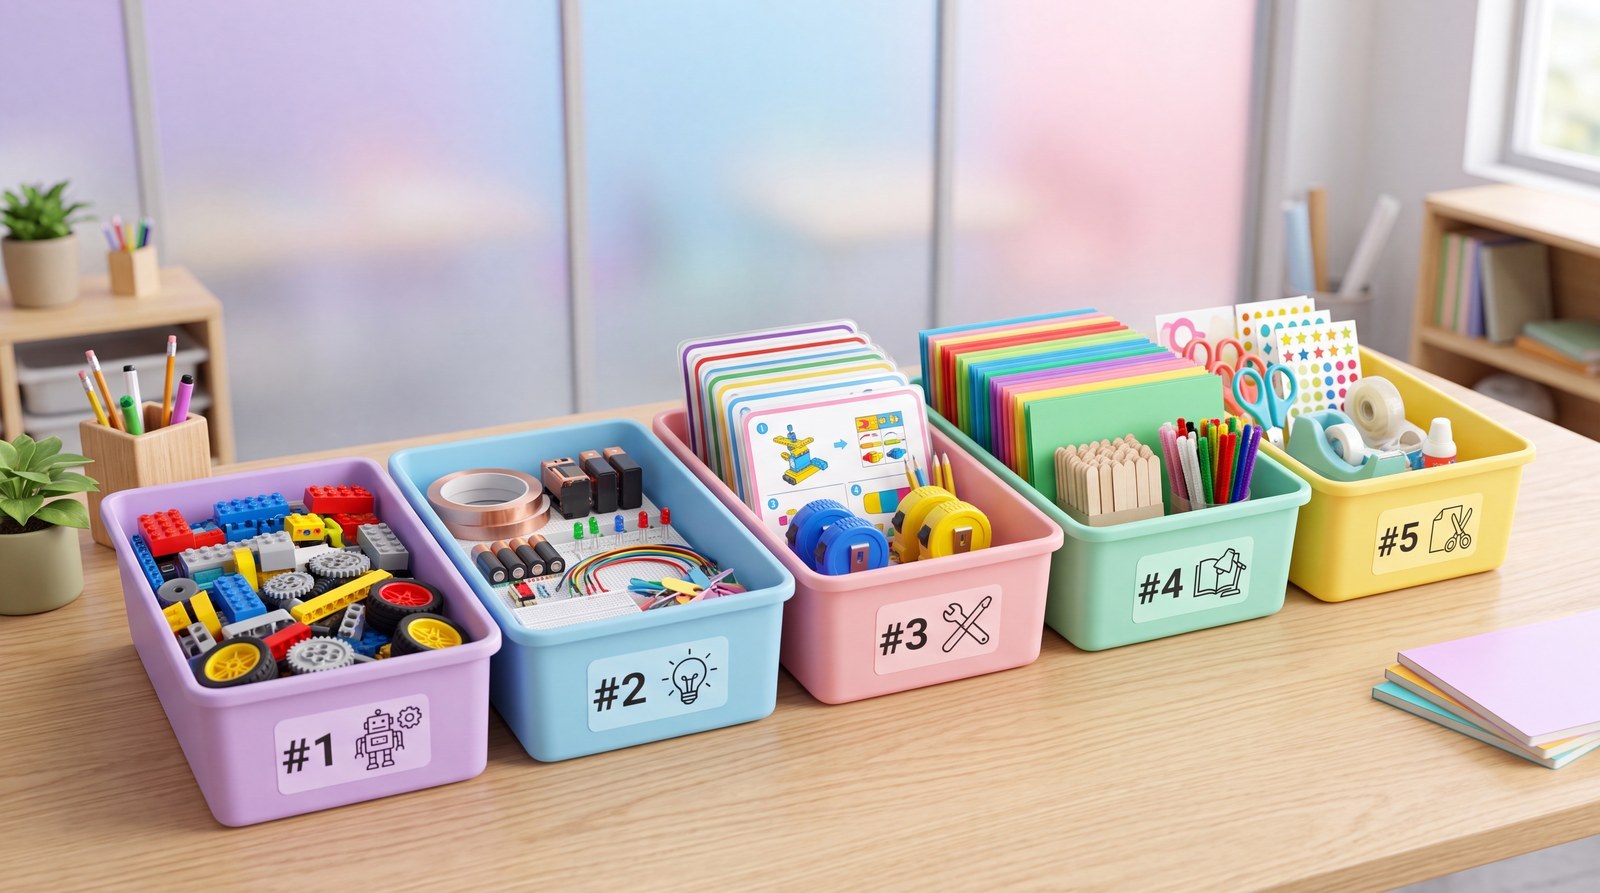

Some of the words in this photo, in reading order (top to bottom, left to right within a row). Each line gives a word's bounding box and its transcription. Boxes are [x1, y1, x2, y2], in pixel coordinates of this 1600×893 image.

[770, 499, 776, 508] 3
[853, 486, 859, 494] 4
[1378, 521, 1420, 558] #5
[1138, 567, 1184, 605] #4
[879, 617, 928, 656] #3
[593, 672, 648, 712] #2
[282, 733, 334, 774] #1
